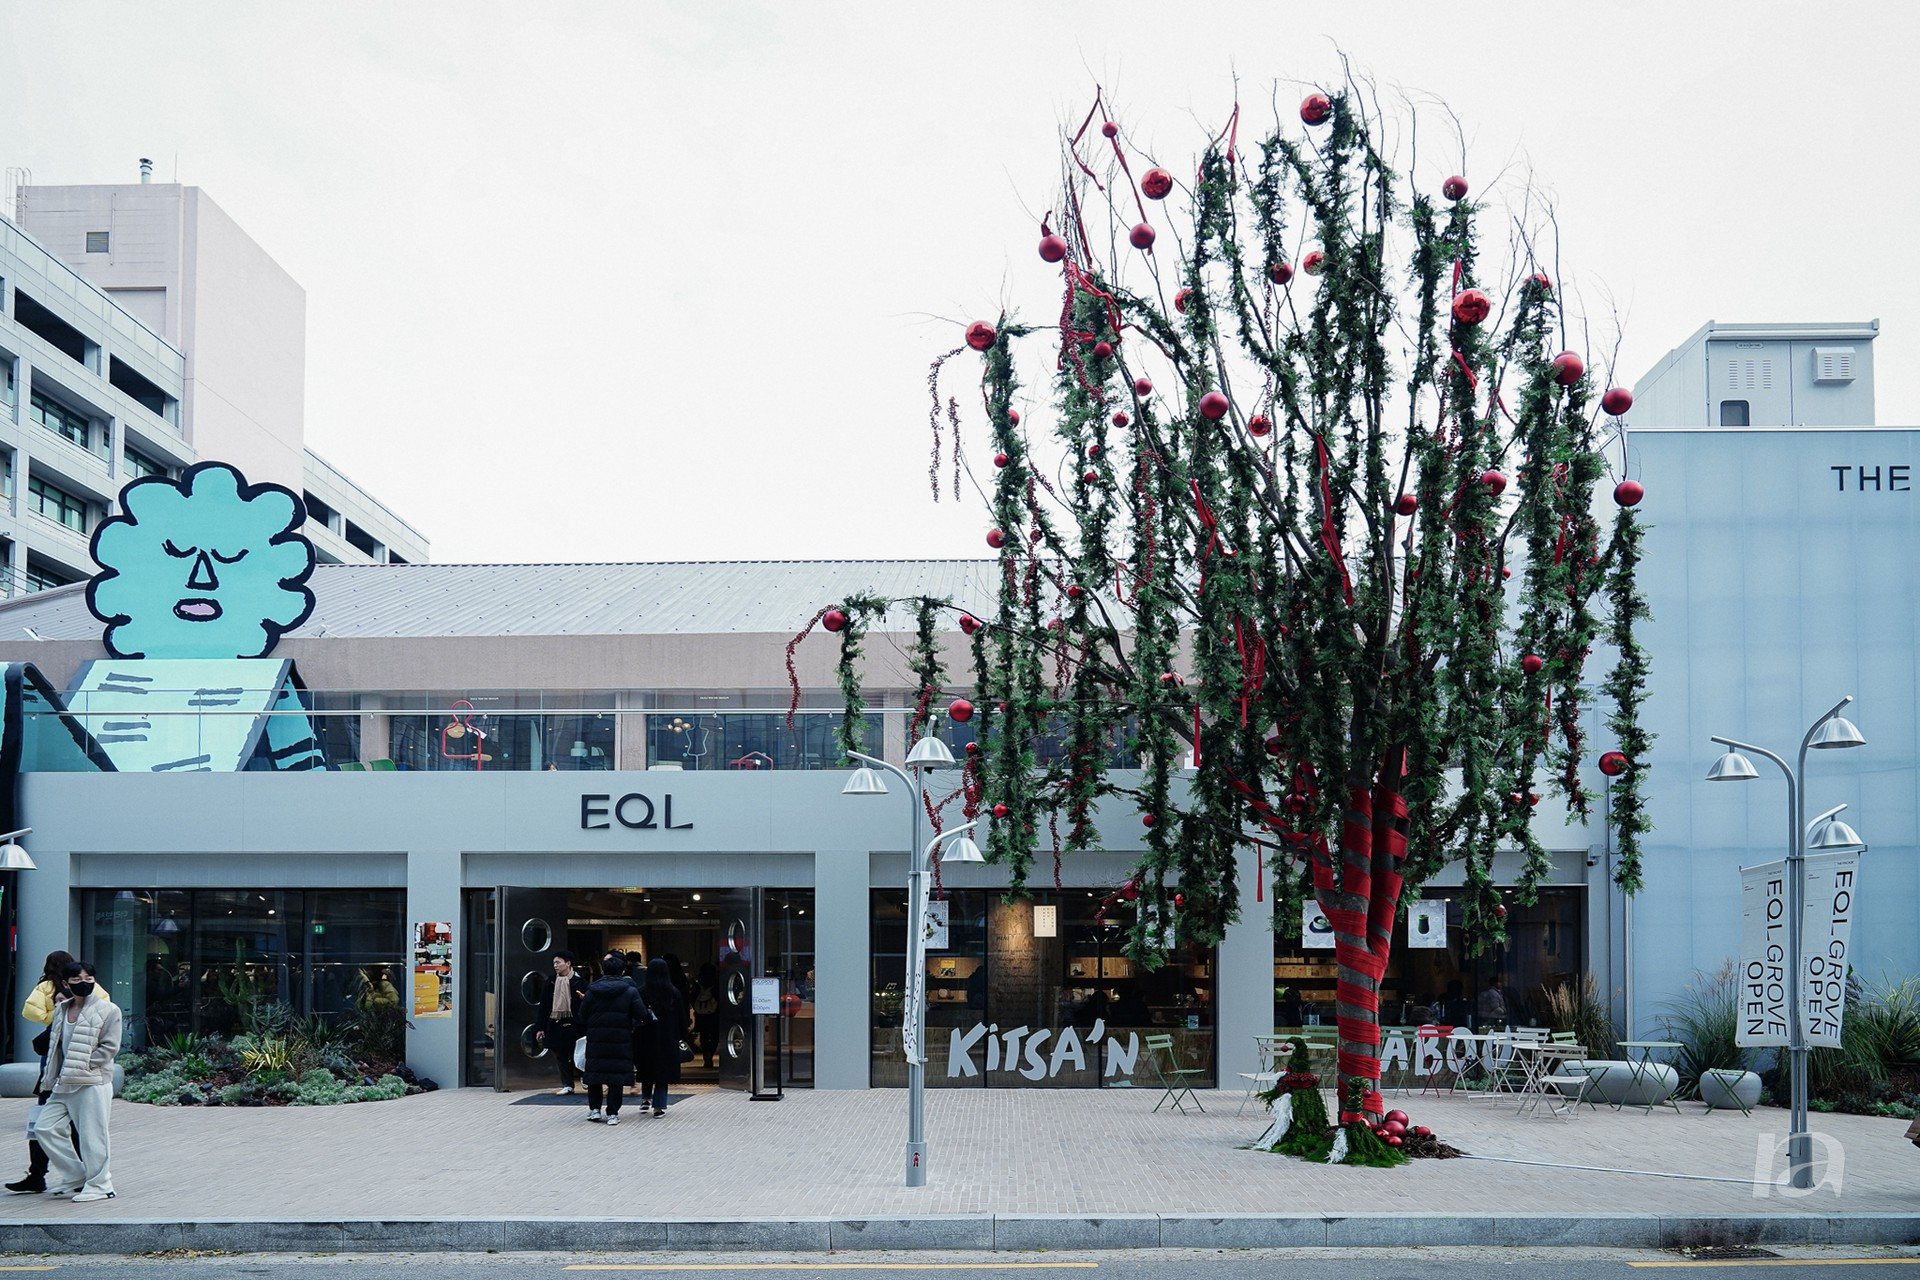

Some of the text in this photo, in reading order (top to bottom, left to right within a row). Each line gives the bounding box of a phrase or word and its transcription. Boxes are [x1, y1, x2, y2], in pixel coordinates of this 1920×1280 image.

[1831, 465, 1911, 492] THE
[580, 793, 694, 830] EQL
[1767, 879, 1784, 941] EQL
[1830, 870, 1853, 936] EQL
[1747, 961, 1764, 1035] OPEN
[1767, 944, 1788, 1037] GROVE
[1808, 956, 1825, 1035] OPEN
[1824, 939, 1845, 1039] GROVE
